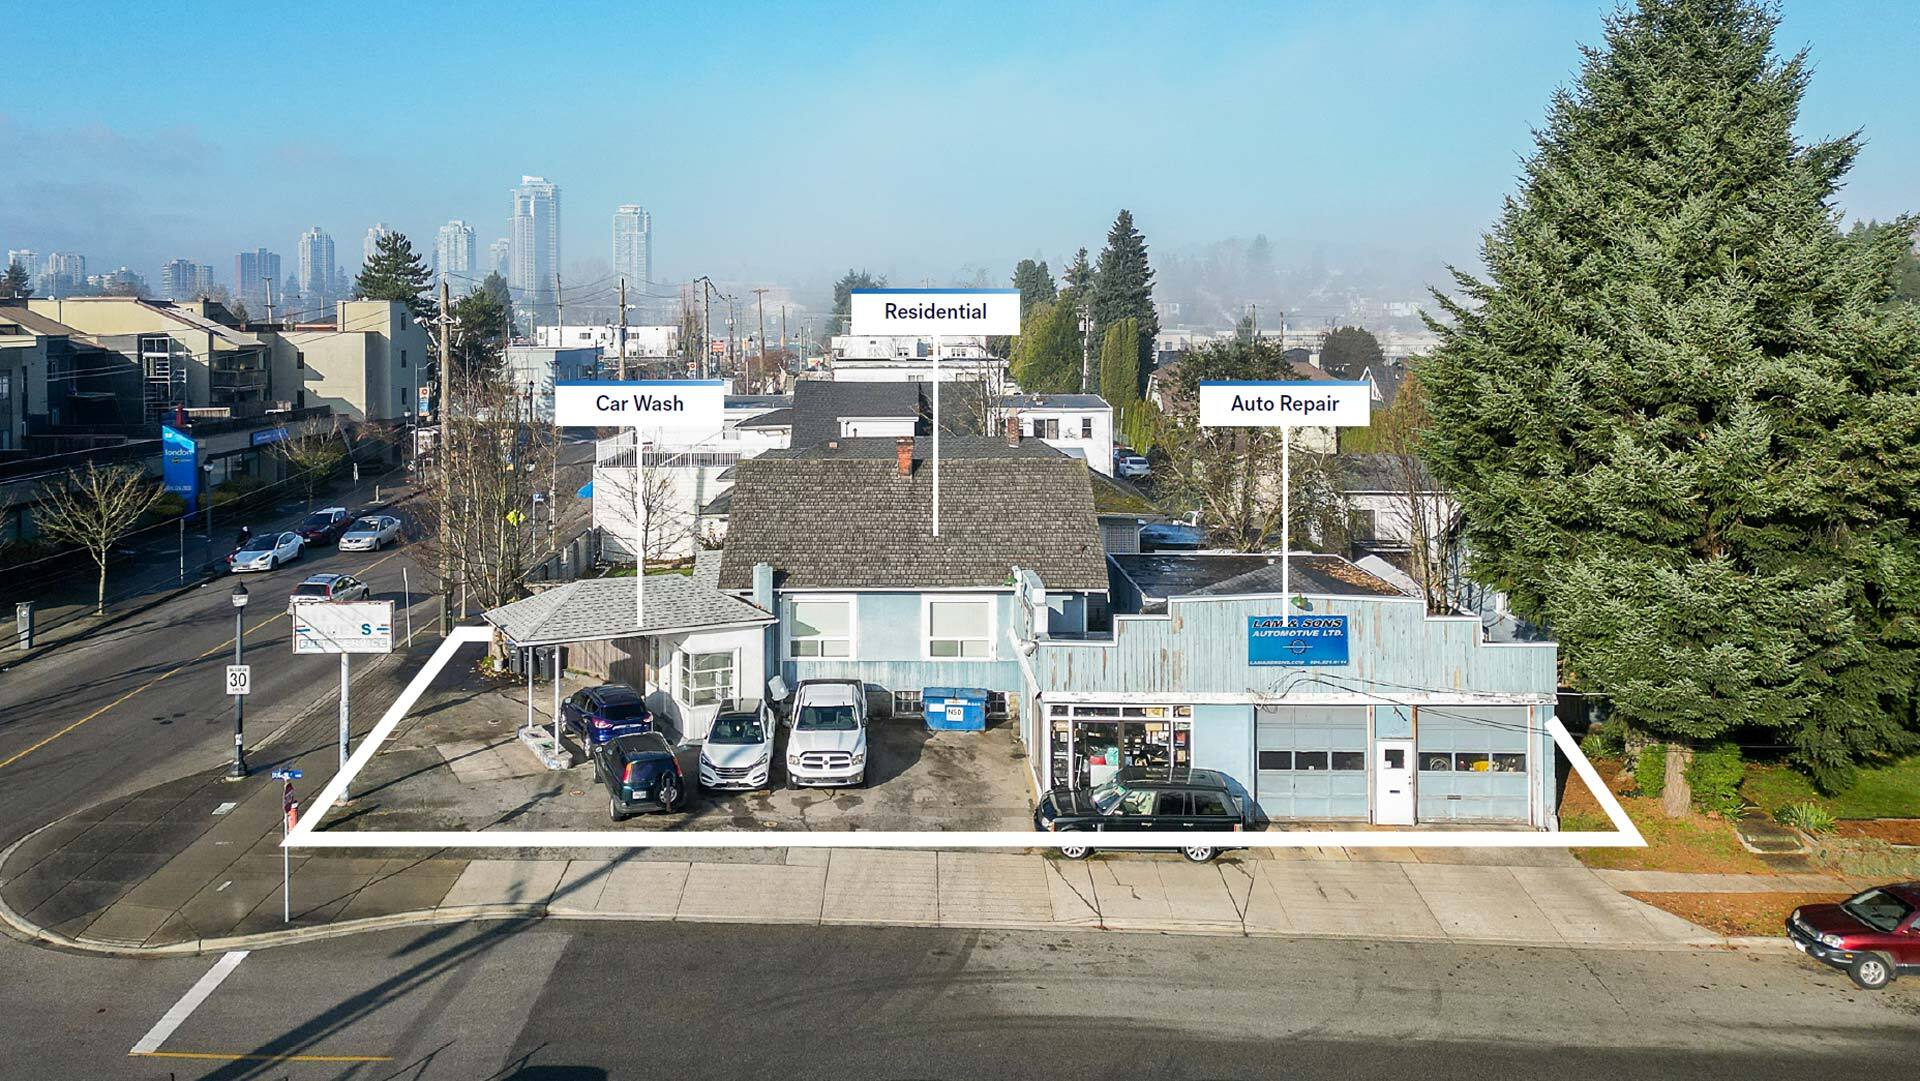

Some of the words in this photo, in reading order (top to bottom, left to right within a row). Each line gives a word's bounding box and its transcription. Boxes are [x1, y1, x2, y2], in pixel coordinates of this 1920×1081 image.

[1253, 619, 1283, 628] LAM
[1287, 618, 1298, 628] &
[1302, 619, 1342, 628] SONS
[229, 672, 247, 687] 30
